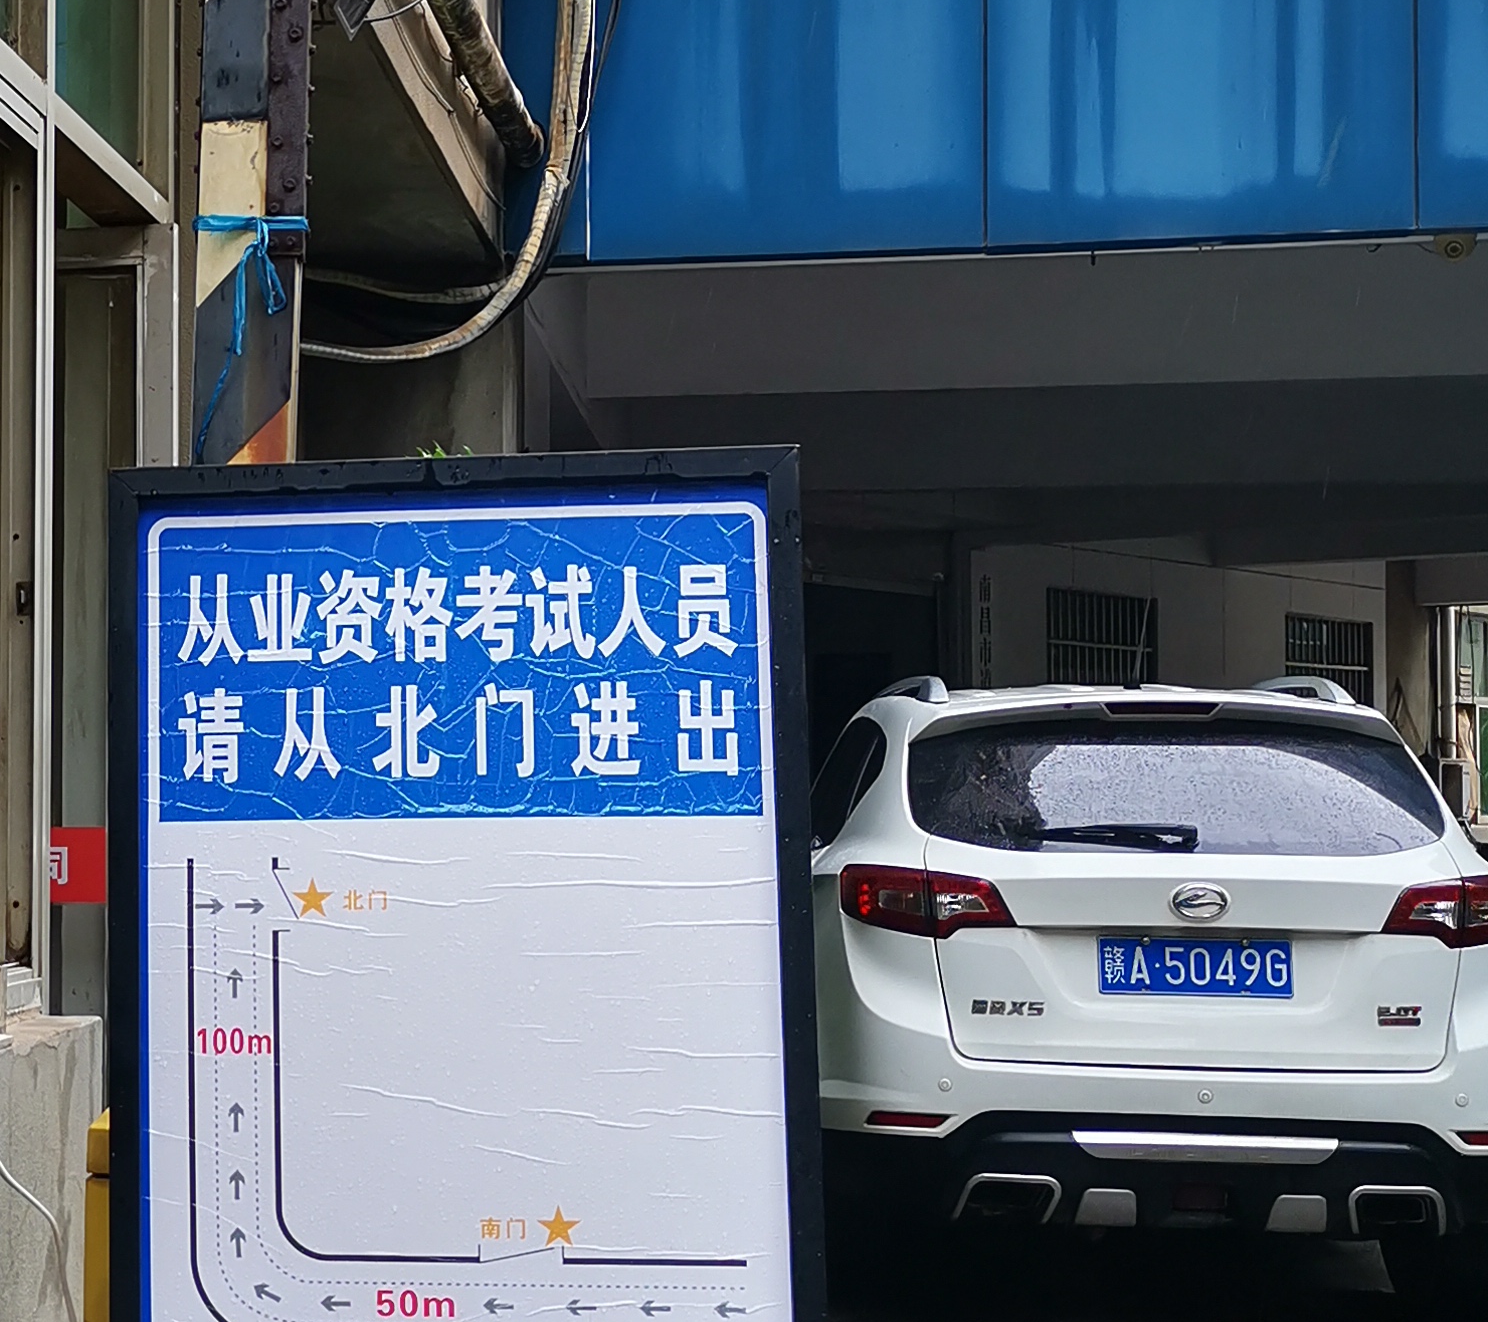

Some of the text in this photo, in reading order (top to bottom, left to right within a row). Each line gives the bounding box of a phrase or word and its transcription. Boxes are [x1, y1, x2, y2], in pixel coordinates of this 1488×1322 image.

[177, 563, 739, 665] 从业资格考试人员
[178, 680, 739, 782] 请从北门进出
[342, 888, 388, 911] 北门
[1103, 946, 1288, 988] 赣A·5049G
[195, 1027, 274, 1056] 100m
[479, 1216, 526, 1240] 南门
[375, 1289, 457, 1319] 50m
